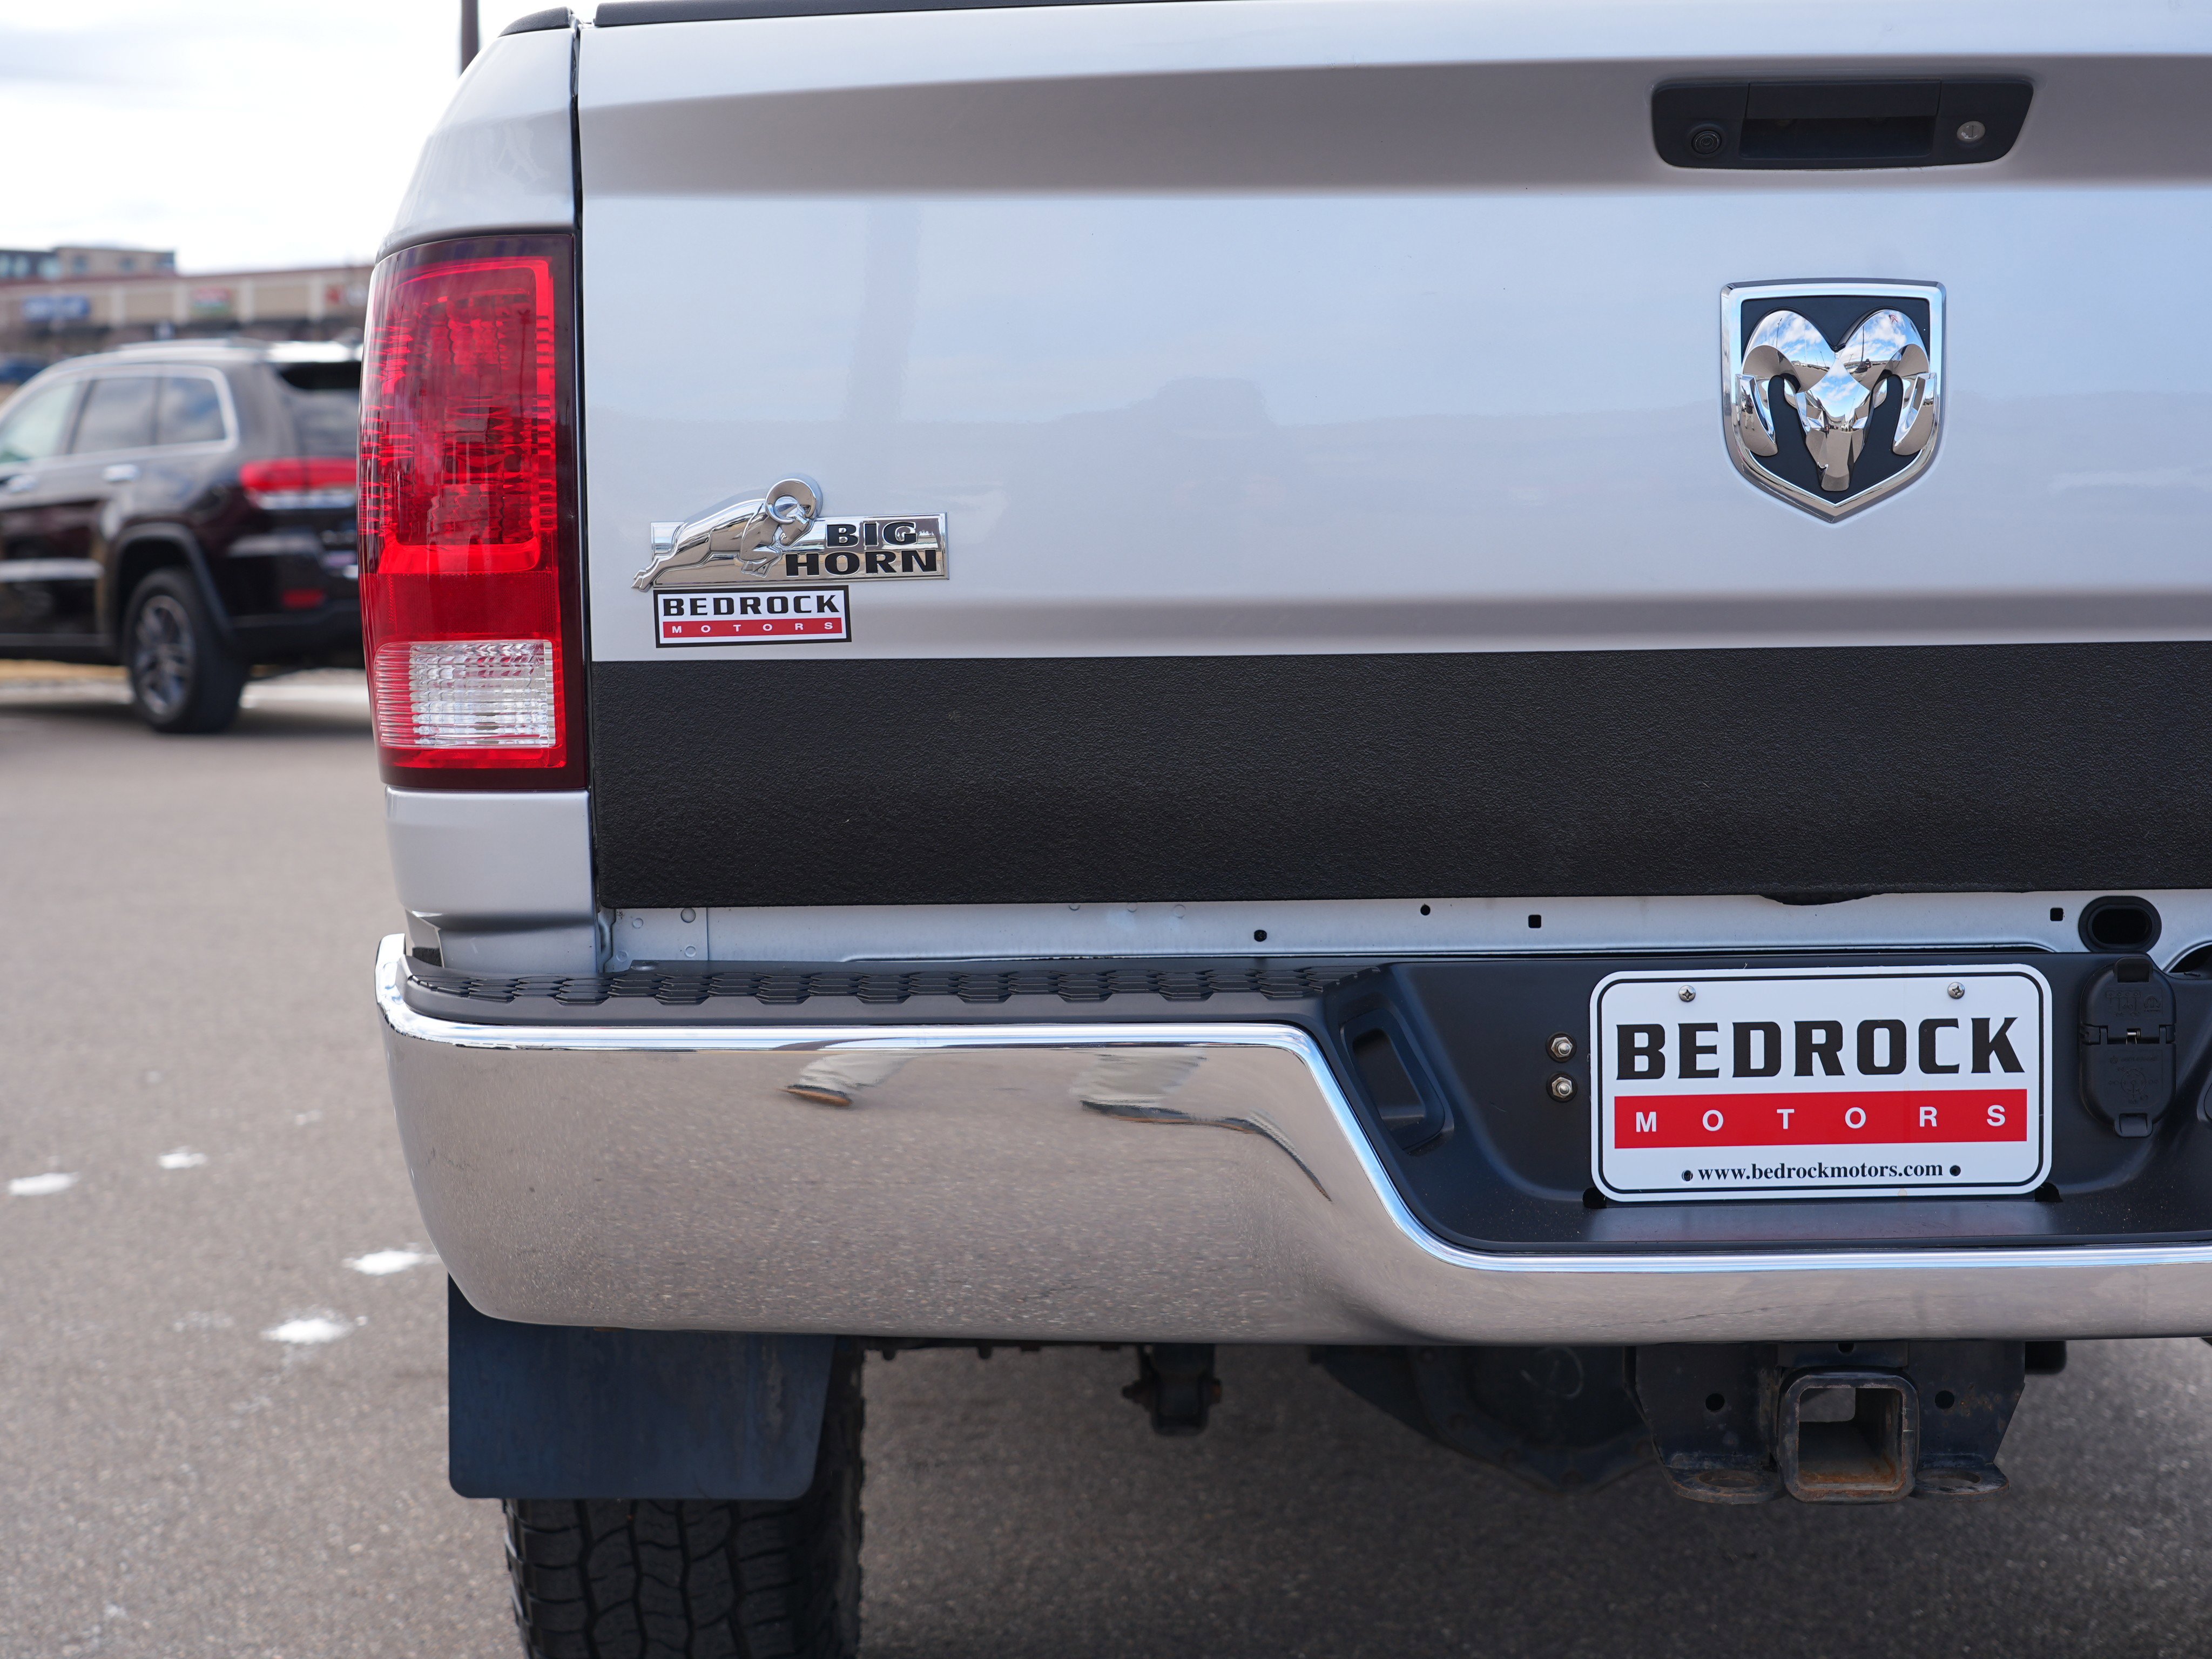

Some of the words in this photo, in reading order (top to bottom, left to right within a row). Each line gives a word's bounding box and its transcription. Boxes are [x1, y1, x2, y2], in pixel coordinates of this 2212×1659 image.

[826, 521, 917, 547] BIG
[785, 549, 937, 576] HORN
[663, 595, 840, 616] BEDROCK
[671, 622, 834, 634] MOTORS
[1616, 1017, 2025, 1080] BEDROCK
[1636, 1104, 2006, 1132] MOTORS
[1697, 1162, 1944, 1181] www.bedrockmotors.com
